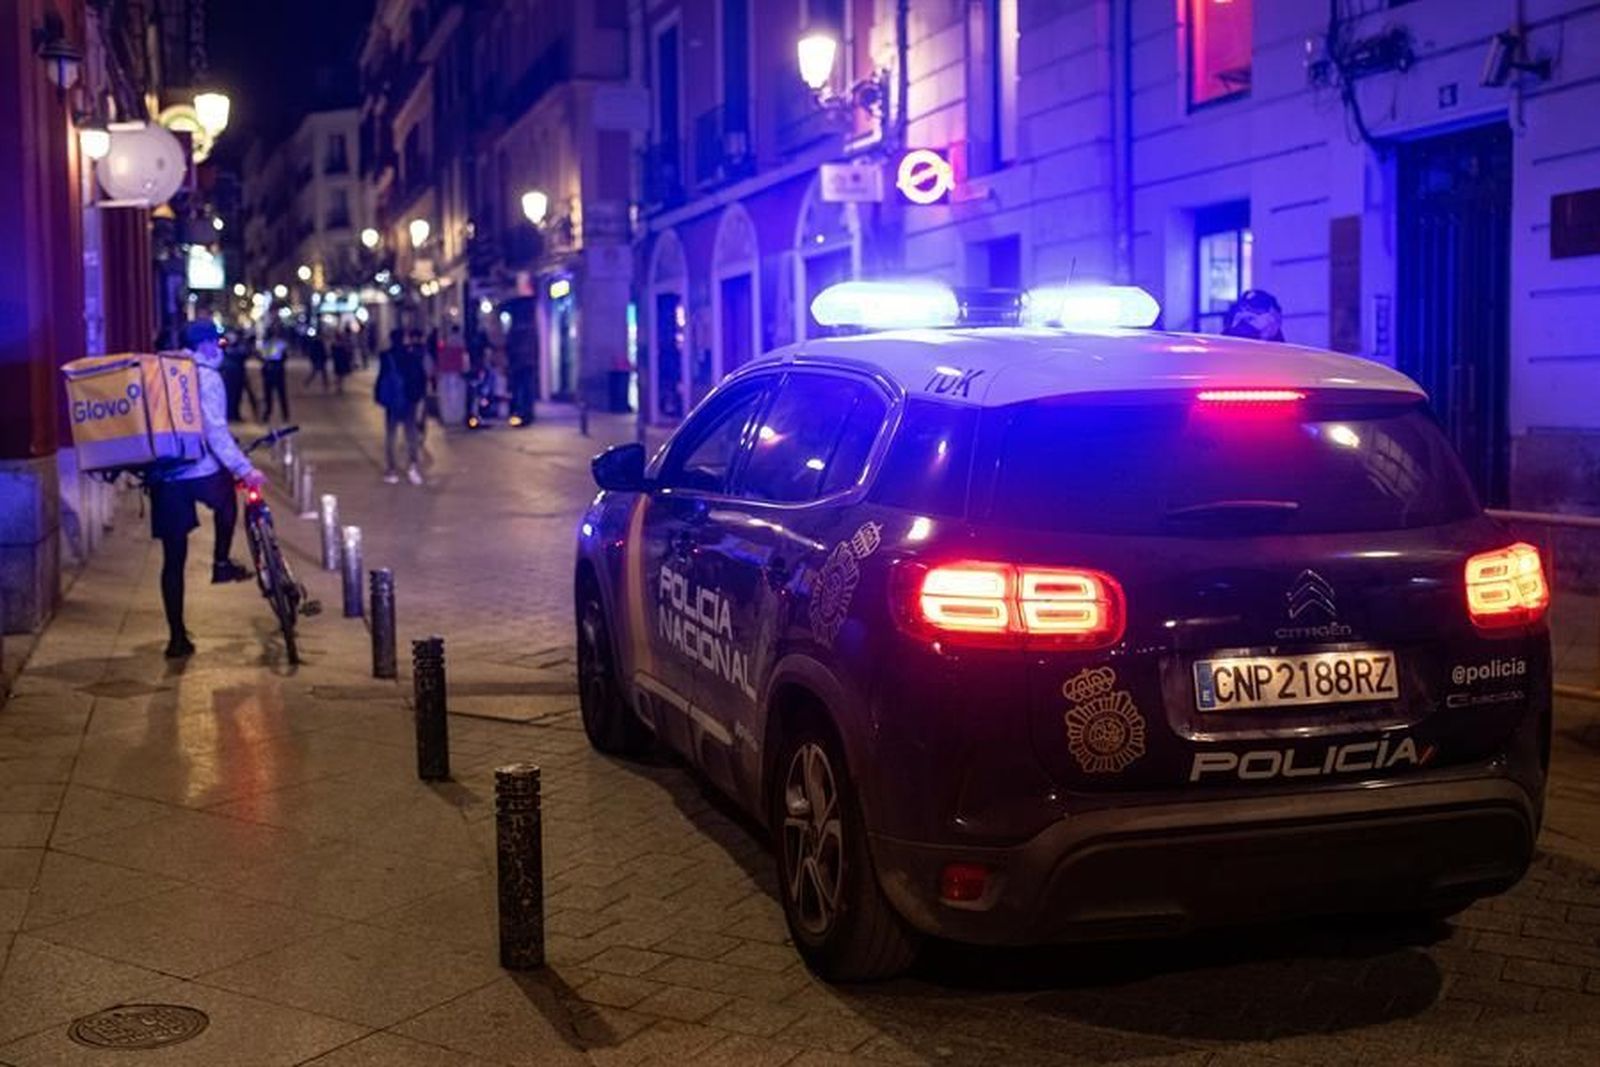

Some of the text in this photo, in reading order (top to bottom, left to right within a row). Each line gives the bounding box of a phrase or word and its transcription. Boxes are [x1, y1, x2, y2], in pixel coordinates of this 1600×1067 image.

[73, 398, 130, 423] Glovo
[659, 565, 733, 641] POLICÍA
[659, 604, 757, 702] NACIONAL
[1452, 657, 1526, 684] @policia
[1189, 732, 1418, 782] POLICÍA
